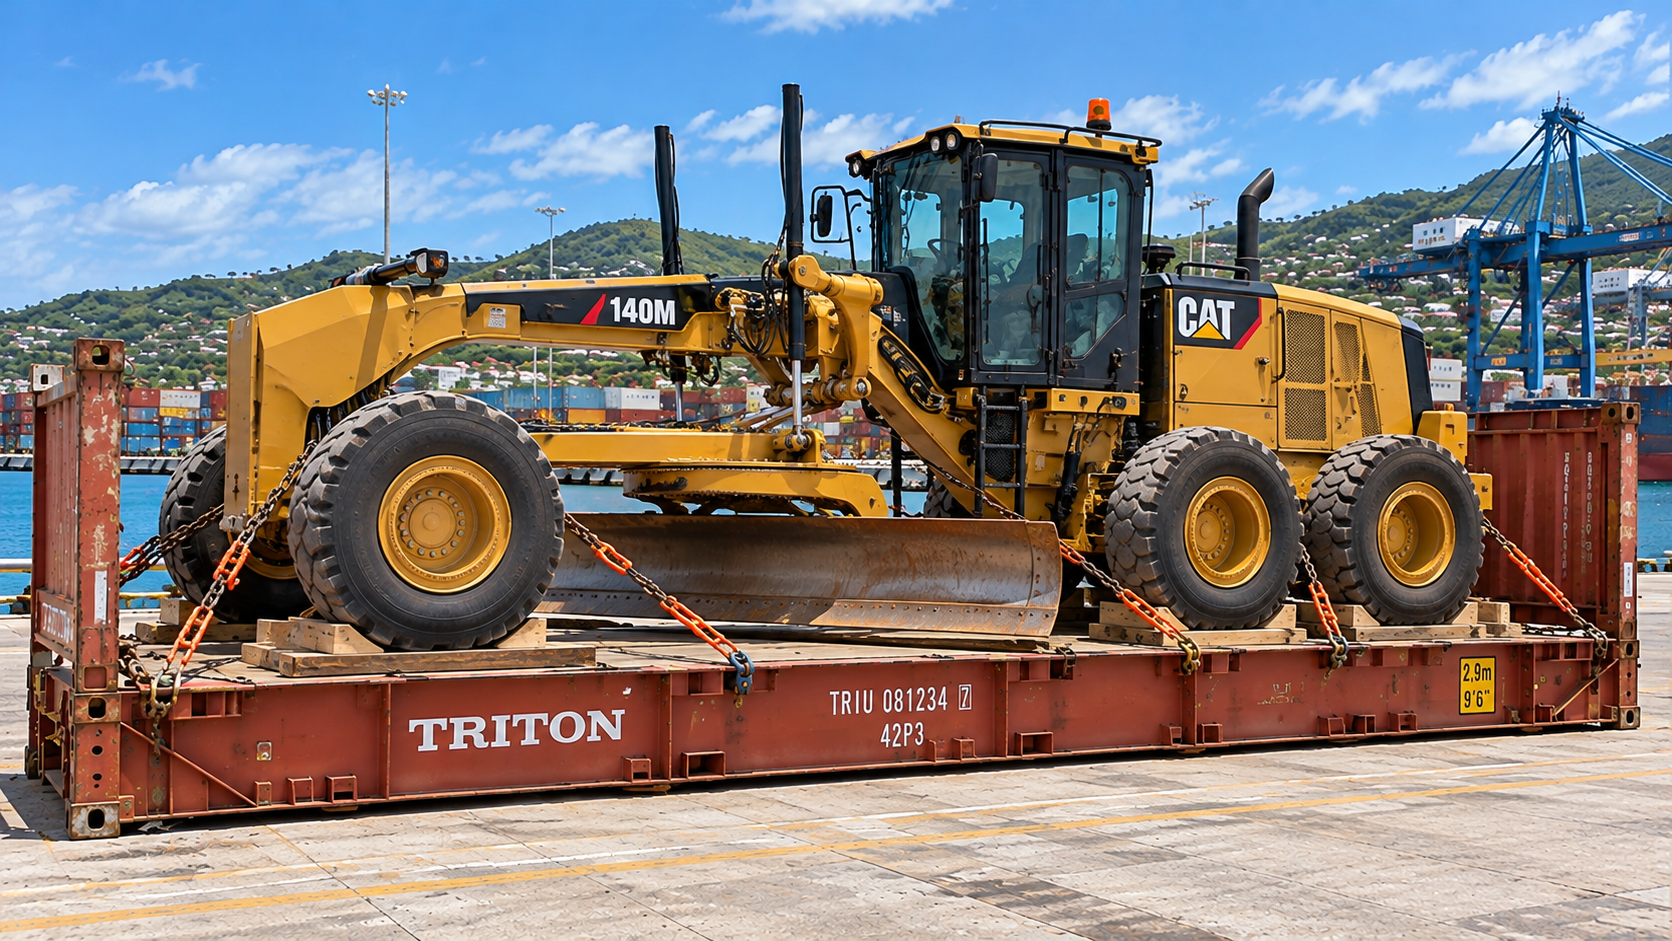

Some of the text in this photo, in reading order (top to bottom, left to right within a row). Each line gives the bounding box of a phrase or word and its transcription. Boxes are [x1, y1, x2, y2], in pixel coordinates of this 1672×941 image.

[610, 296, 676, 325] 140M
[1178, 296, 1235, 341] CAT
[829, 685, 970, 715] TRIU 081234 7
[408, 709, 625, 752] TRITON
[880, 722, 924, 748] 42P3
